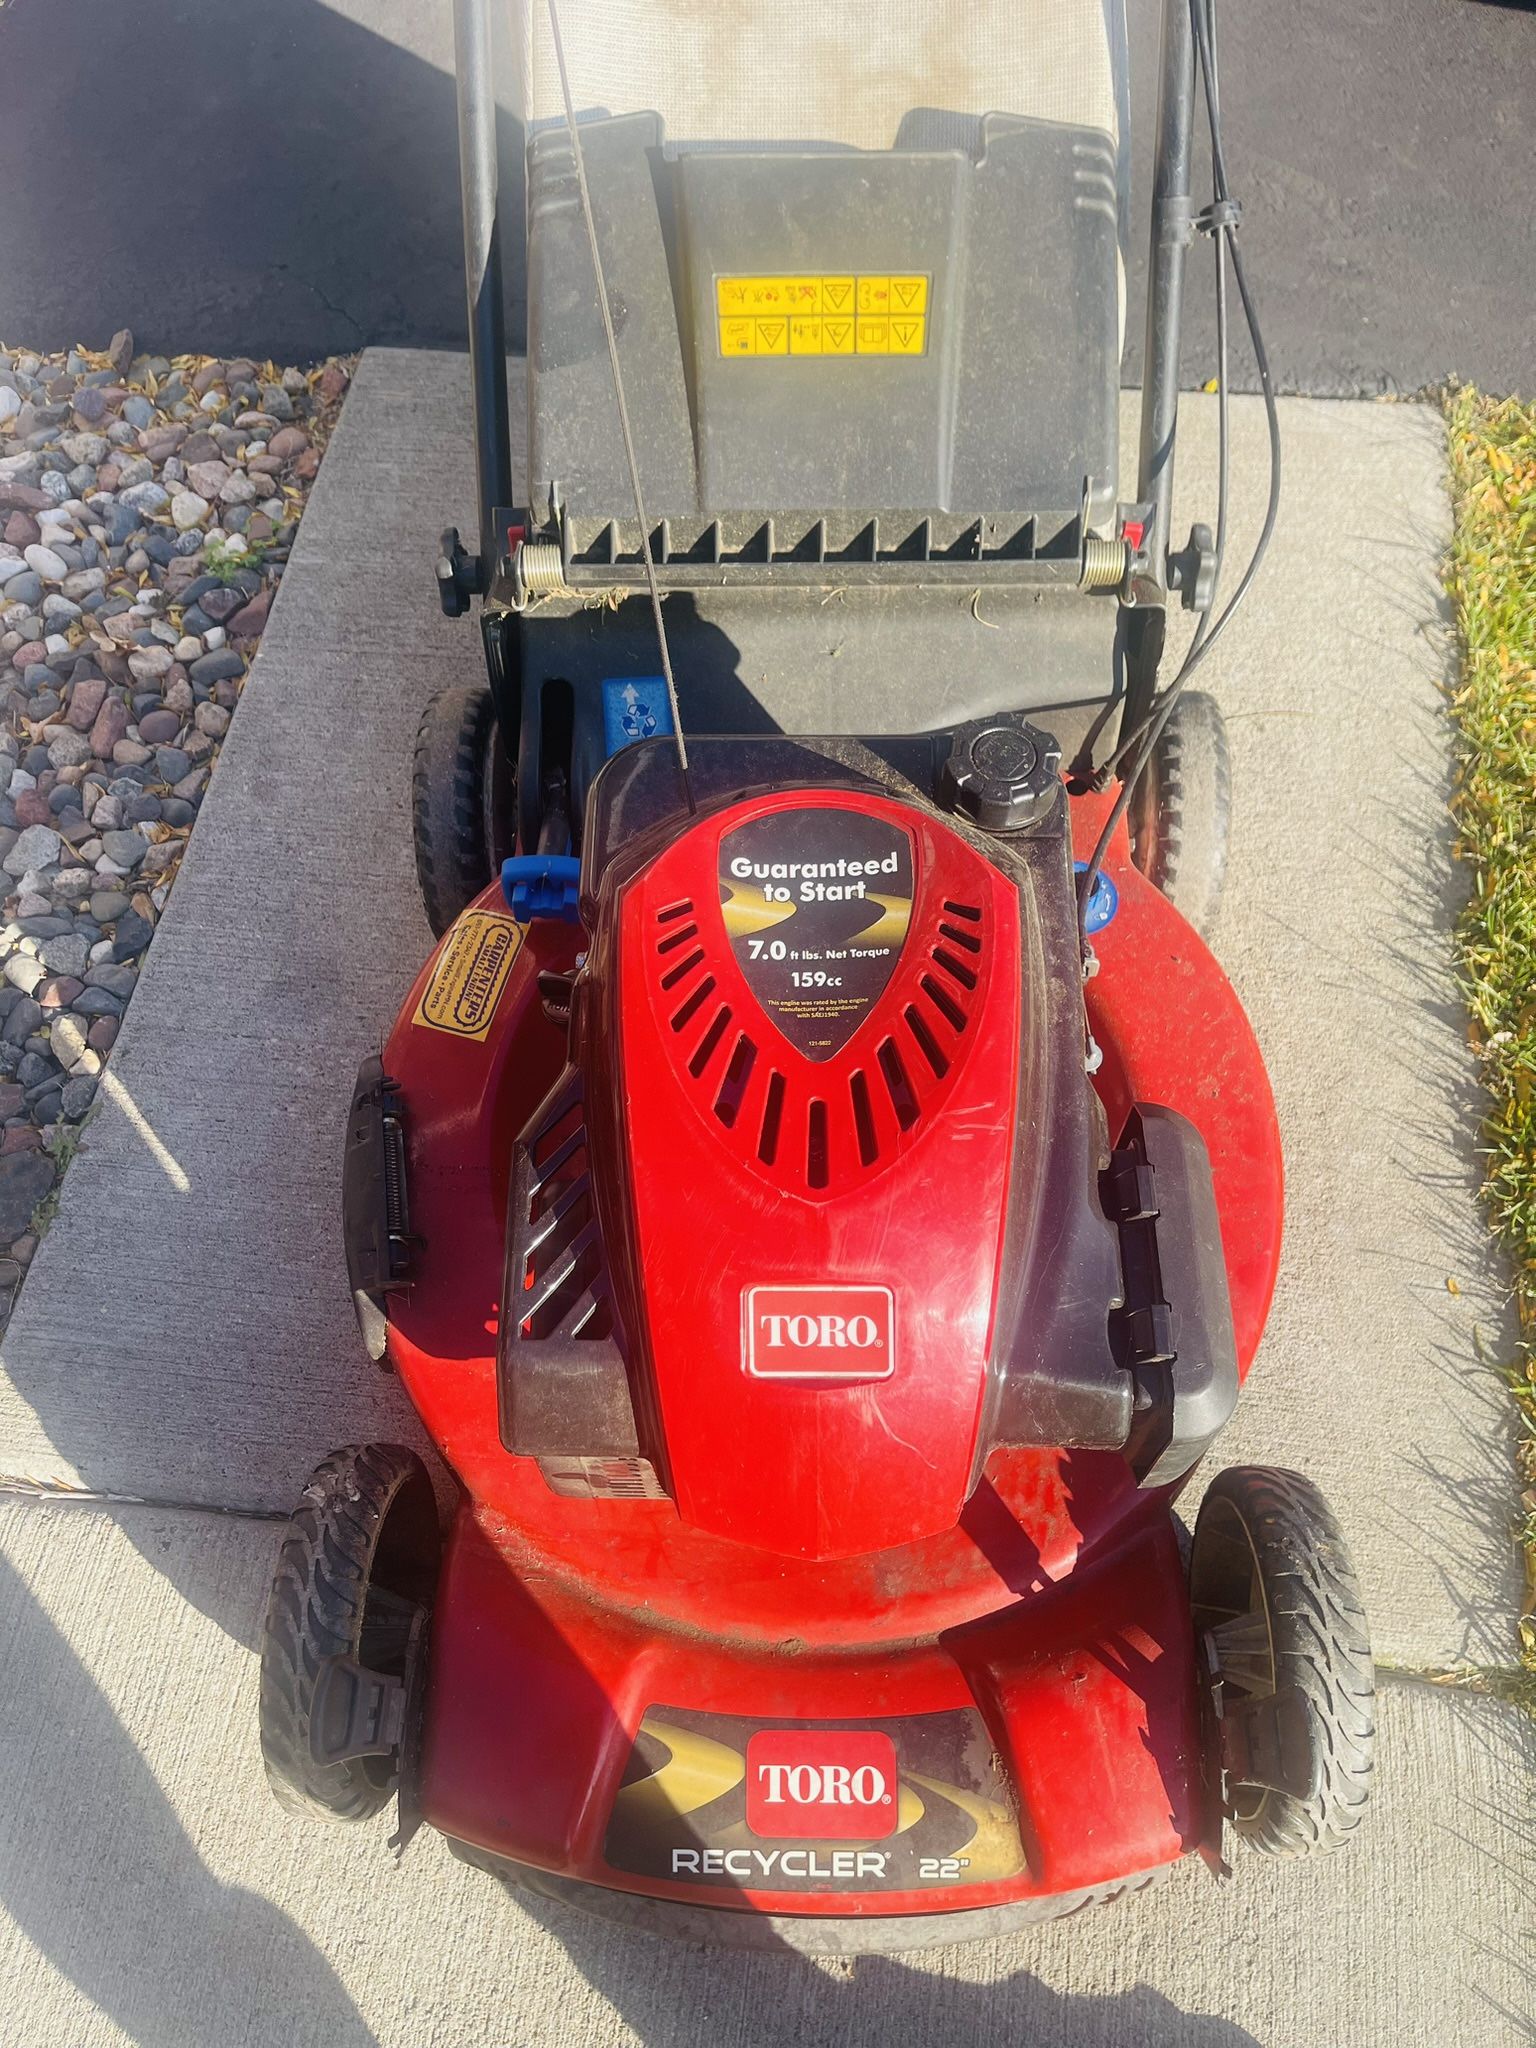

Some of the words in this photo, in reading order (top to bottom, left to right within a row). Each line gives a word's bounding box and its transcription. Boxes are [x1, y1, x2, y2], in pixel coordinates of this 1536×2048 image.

[730, 851, 898, 879] Guaranteed
[763, 884, 791, 902] to
[800, 881, 866, 902] Start
[475, 943, 492, 973] SMALL
[748, 940, 786, 961] 7.0
[790, 951, 799, 961] ft
[802, 949, 822, 960] lbs.
[826, 949, 847, 960] Net
[850, 947, 890, 959] Torque
[441, 949, 460, 982] Service
[464, 933, 508, 1021] CARPENTERS
[463, 972, 481, 1003] ENGINE
[791, 972, 842, 988] 159cc
[430, 986, 445, 1010] Parts
[849, 997, 869, 1005] engine
[919, 1857, 971, 1879] 22"
